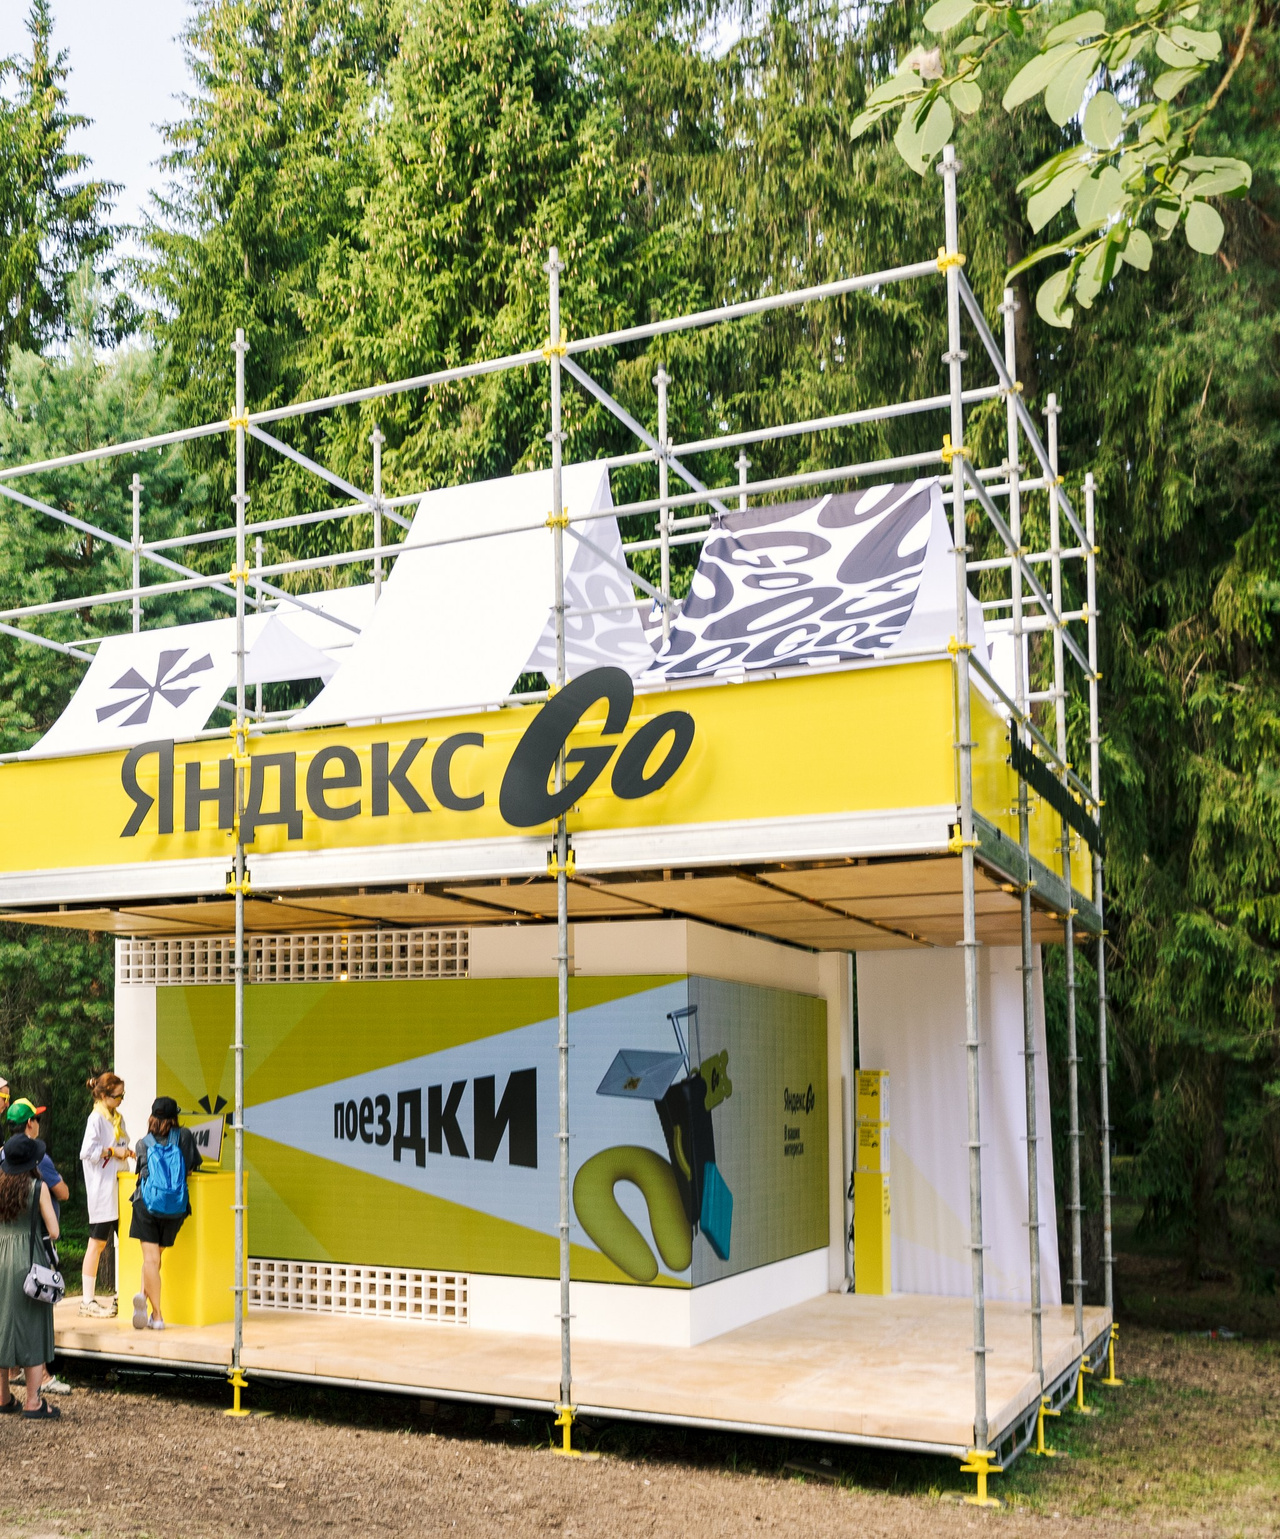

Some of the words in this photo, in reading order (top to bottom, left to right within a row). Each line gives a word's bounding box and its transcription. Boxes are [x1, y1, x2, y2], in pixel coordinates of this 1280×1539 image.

[120, 732, 485, 844] Яндекс
[499, 666, 696, 828] Go
[711, 1066, 720, 1094] Go
[784, 1087, 806, 1115] Яндекс
[805, 1083, 815, 1115] Go
[333, 1067, 538, 1169] поездки
